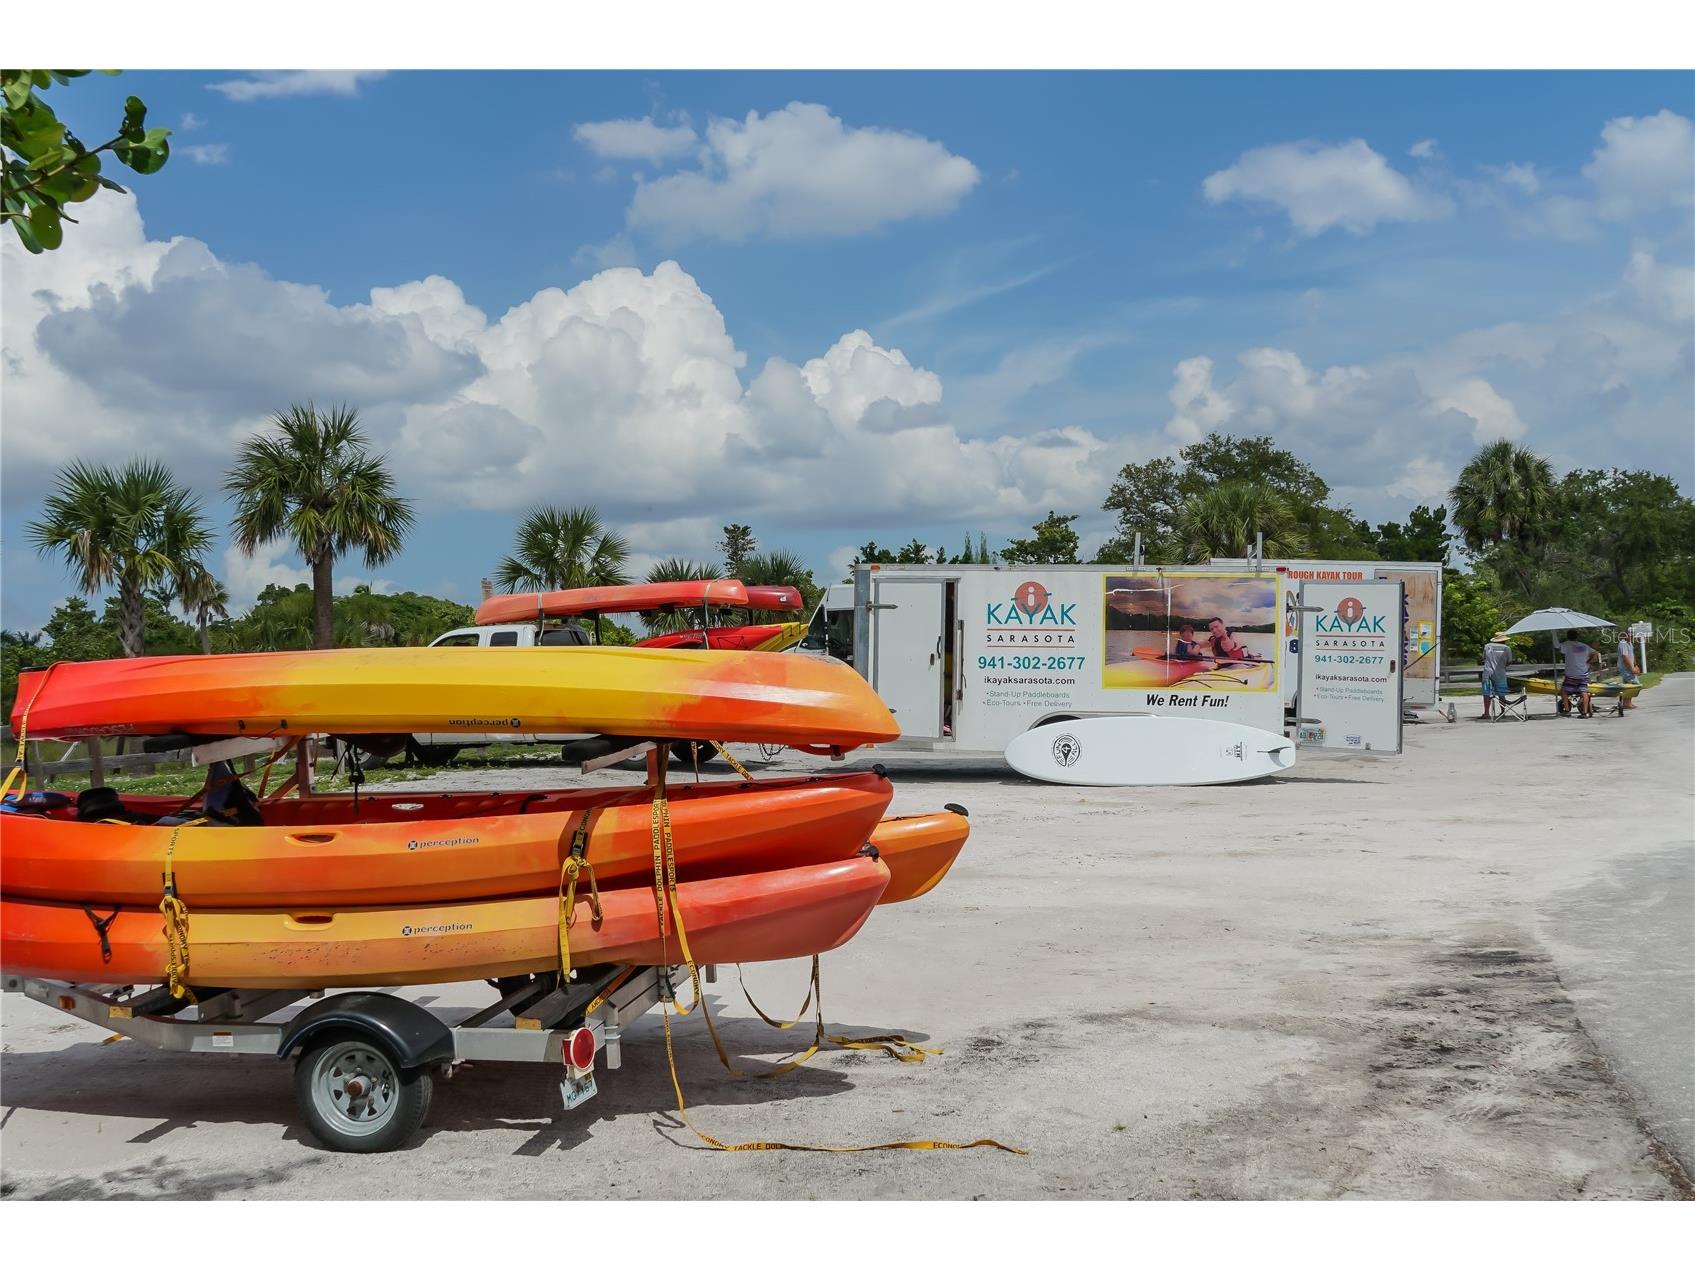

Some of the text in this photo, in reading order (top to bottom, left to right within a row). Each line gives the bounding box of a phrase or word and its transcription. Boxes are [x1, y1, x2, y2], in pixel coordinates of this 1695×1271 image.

[1316, 571, 1340, 580] KAYAK
[1343, 571, 1363, 581] TOUR
[986, 603, 1076, 625] KAYAK
[1315, 615, 1386, 633] KAYAK
[986, 634, 1075, 643] SARASOTA
[1315, 640, 1385, 648] SARASOTA
[978, 655, 1086, 670] 941-302-2677
[1314, 654, 1384, 665] 941-302-2677
[984, 675, 1075, 686] ikayaksarasota.com
[1315, 673, 1388, 684] ikayaksarasota.com
[1022, 690, 1070, 699] Paddleboards
[1146, 694, 1229, 708] We Rent Fun!
[448, 718, 509, 727] perception
[420, 836, 480, 848] perception
[655, 855, 663, 892] DOLPHIN
[414, 922, 474, 934] perception
[687, 960, 700, 995] ECONOMY
